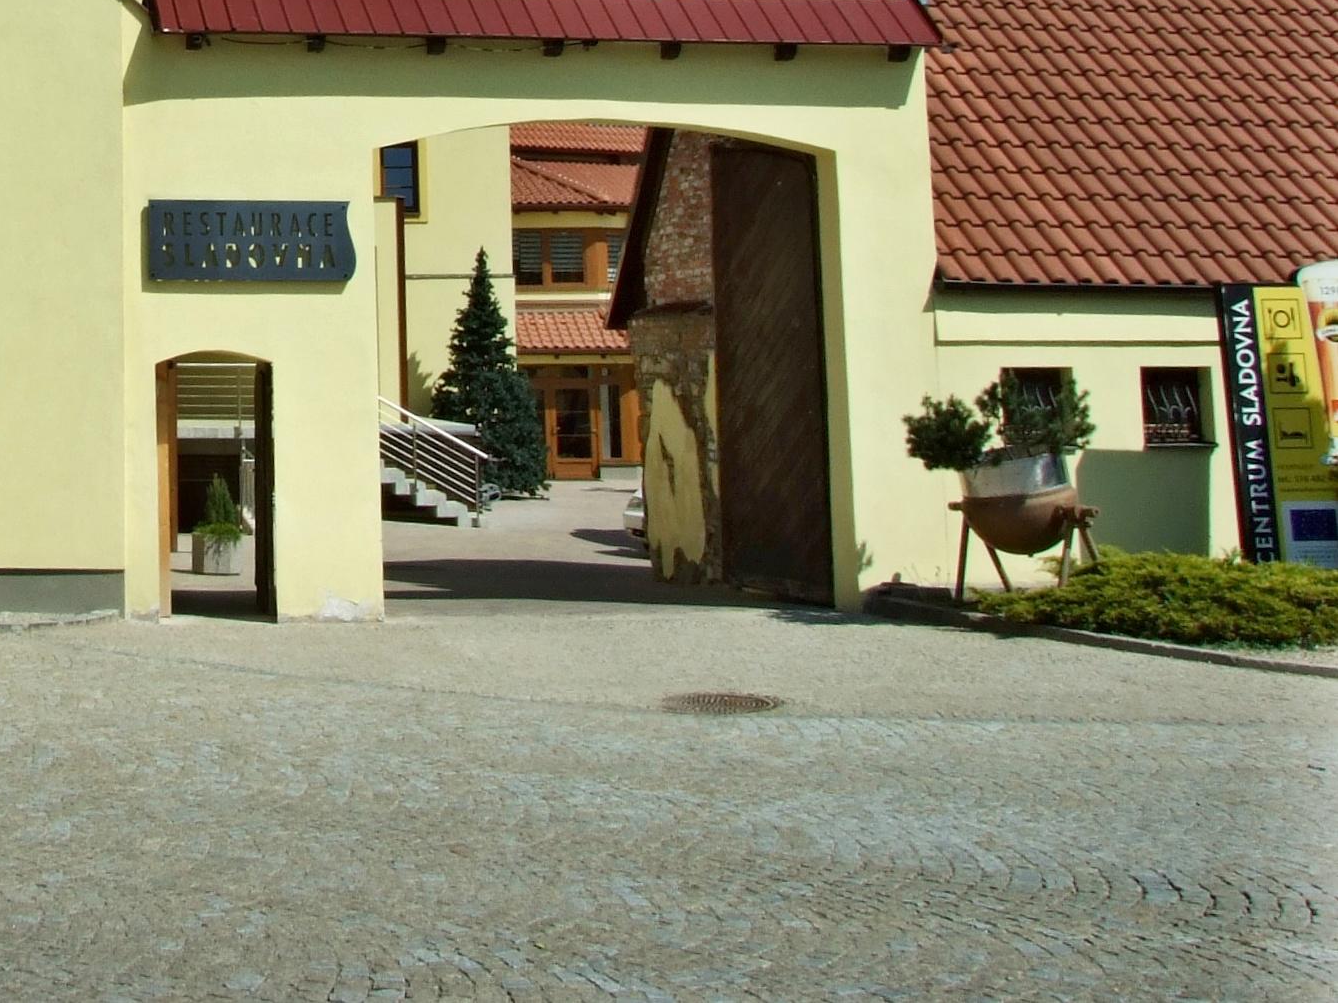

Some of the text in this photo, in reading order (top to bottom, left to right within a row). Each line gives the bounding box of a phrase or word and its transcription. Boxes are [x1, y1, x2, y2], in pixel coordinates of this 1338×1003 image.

[162, 211, 335, 238] RESTAURACE
[161, 242, 337, 270] SLADOVNA
[1231, 298, 1262, 427] SLADOVNA
